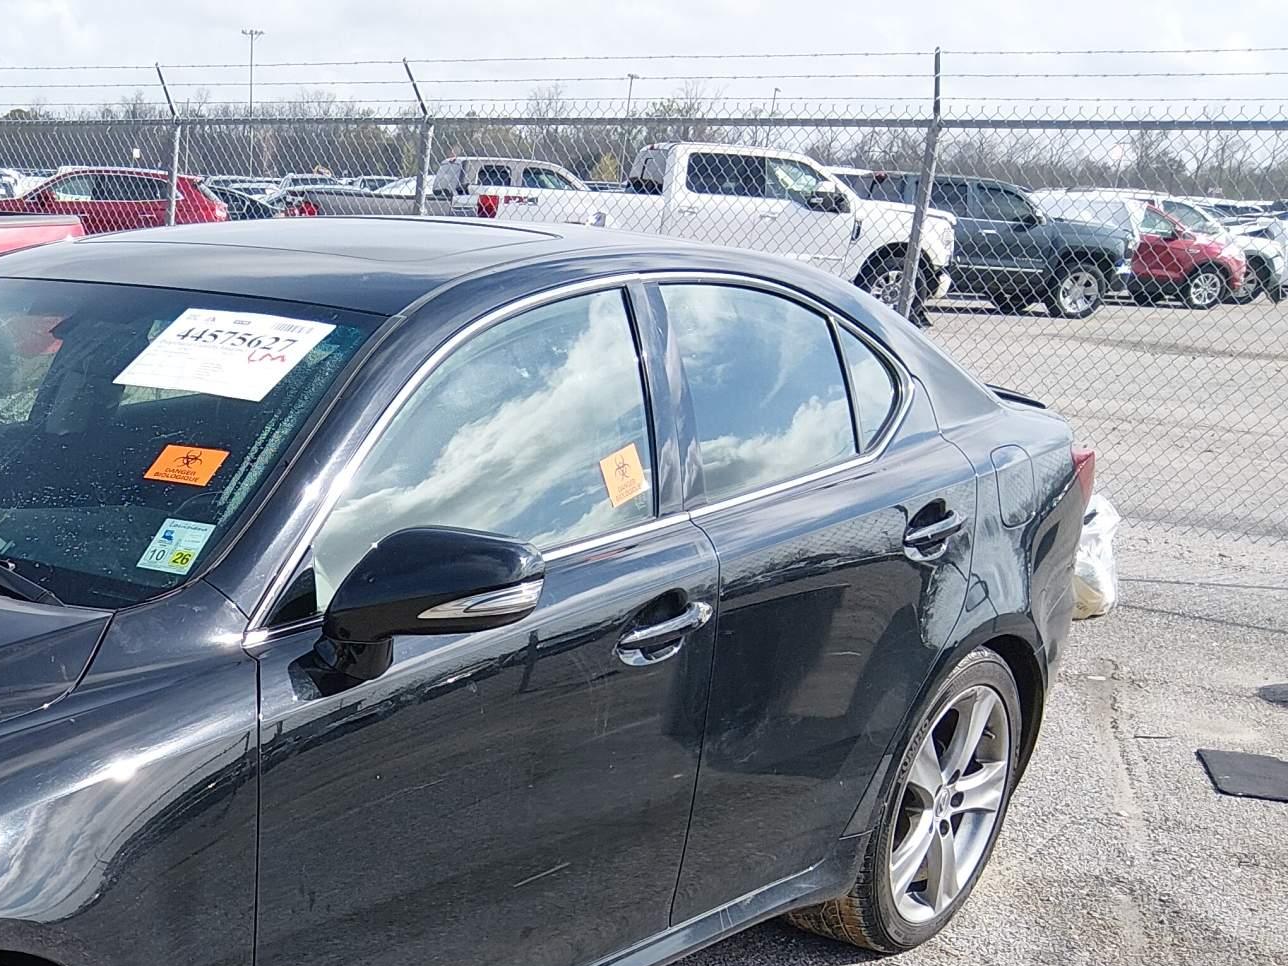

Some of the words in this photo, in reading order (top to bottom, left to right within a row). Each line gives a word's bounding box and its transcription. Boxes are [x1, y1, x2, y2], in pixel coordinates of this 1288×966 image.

[175, 327, 300, 354] 44575627
[153, 471, 200, 482] BIOLOGIQUE
[165, 467, 197, 477] DANGER
[148, 548, 167, 561] 10
[171, 551, 192, 566] 26
[897, 718, 929, 784] KUMHO
